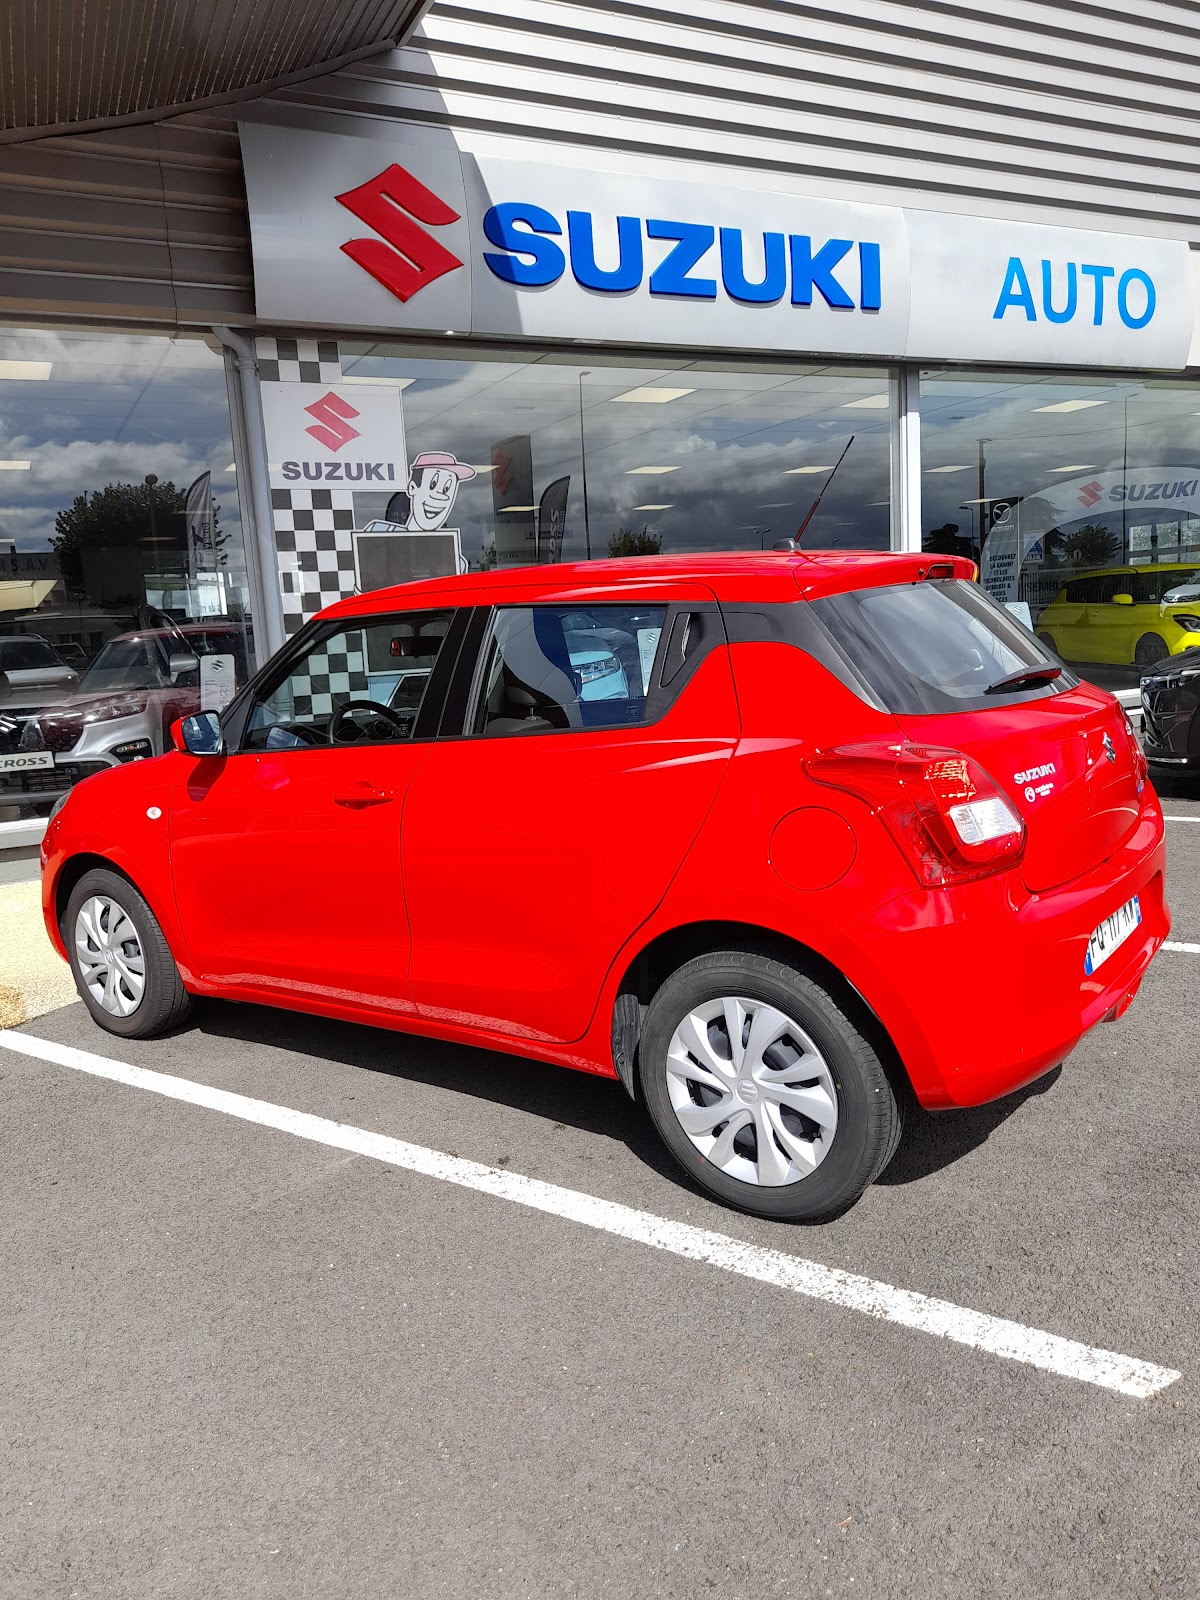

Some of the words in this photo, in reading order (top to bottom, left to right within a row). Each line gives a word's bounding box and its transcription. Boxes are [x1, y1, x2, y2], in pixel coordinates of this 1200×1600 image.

[482, 202, 881, 310] SUZUKI
[993, 257, 1156, 329] AUTO
[281, 461, 395, 481] SUZUKI
[1108, 480, 1199, 502] SUZUKI
[1013, 762, 1056, 785] SUZUKI
